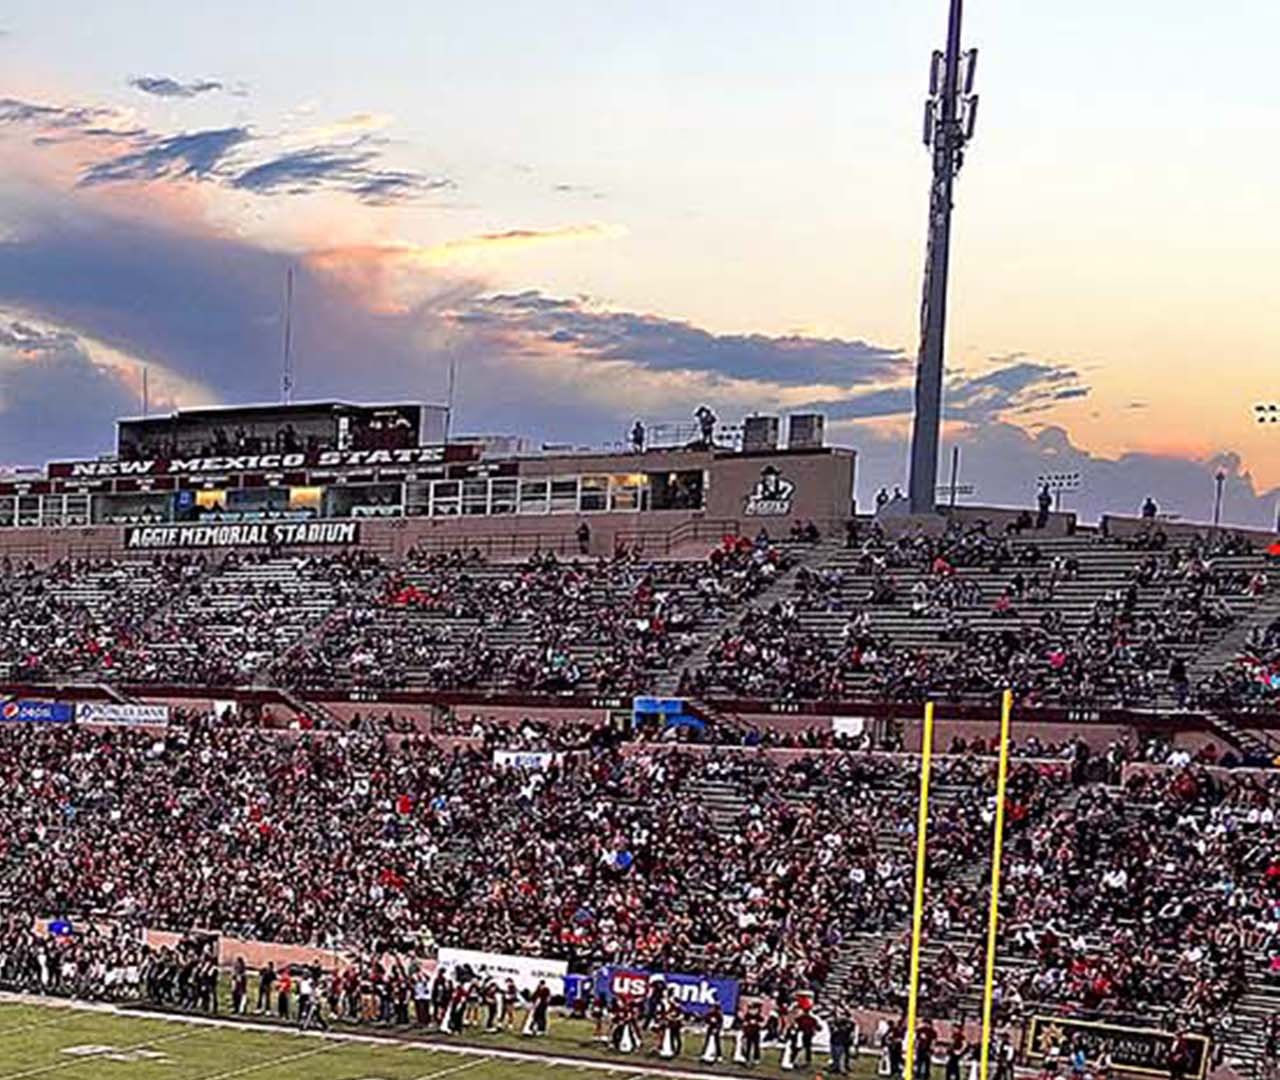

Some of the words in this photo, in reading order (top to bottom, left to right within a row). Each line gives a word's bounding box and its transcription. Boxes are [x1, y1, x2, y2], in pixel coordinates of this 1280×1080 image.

[71, 459, 155, 476] NEW
[168, 454, 306, 472] MEXICO
[317, 447, 445, 465] STATE
[129, 527, 178, 548] AGGIE
[180, 524, 269, 545] MEMORIAL
[274, 522, 357, 543] STADIUM
[613, 977, 646, 996] us
